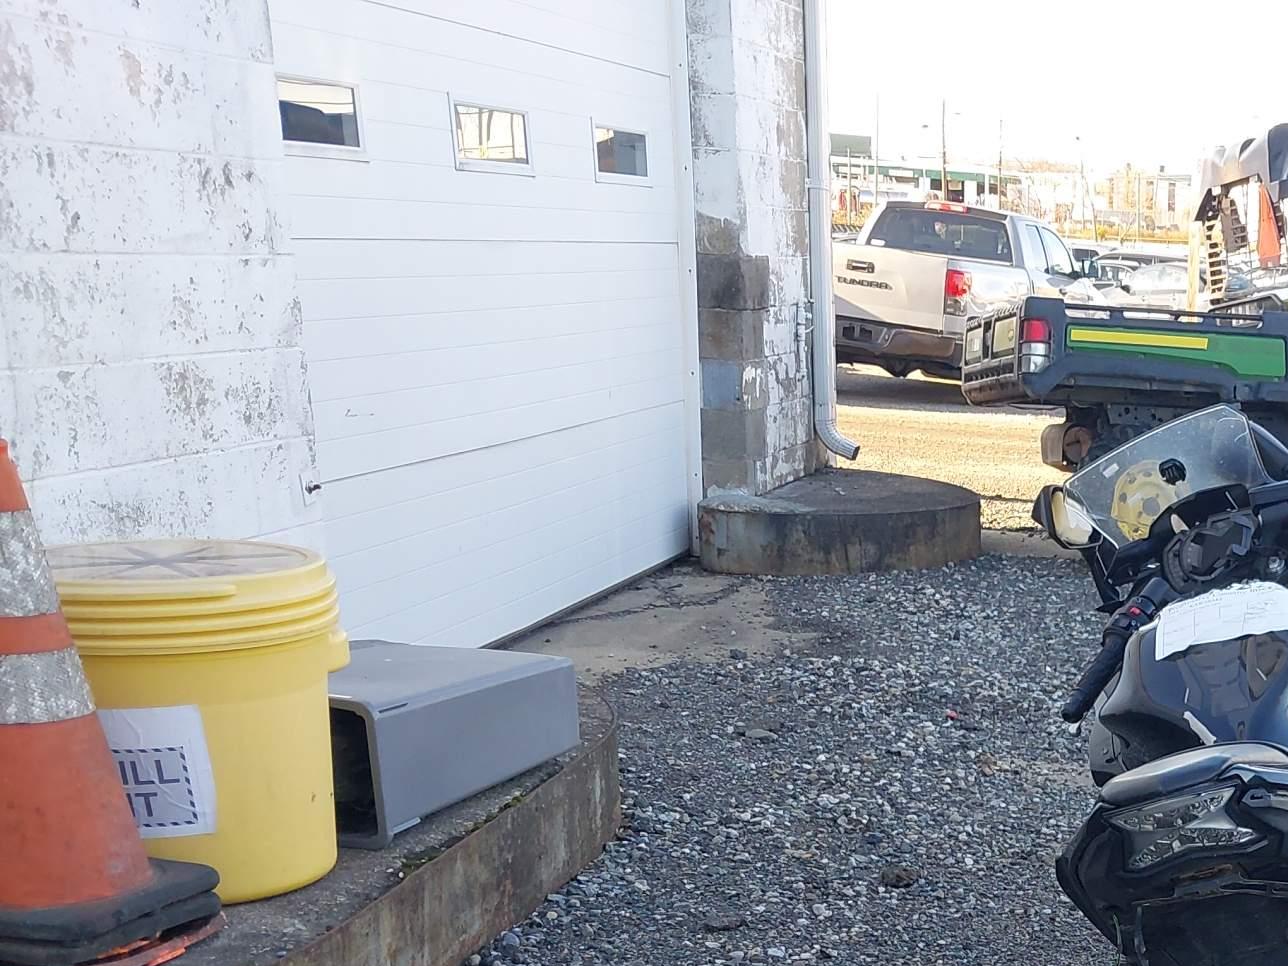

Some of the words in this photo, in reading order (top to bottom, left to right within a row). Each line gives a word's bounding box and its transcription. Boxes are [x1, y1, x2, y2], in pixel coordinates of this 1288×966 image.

[835, 275, 893, 290] TUNDRA
[118, 759, 181, 786] ILL
[125, 792, 158, 818] IT
